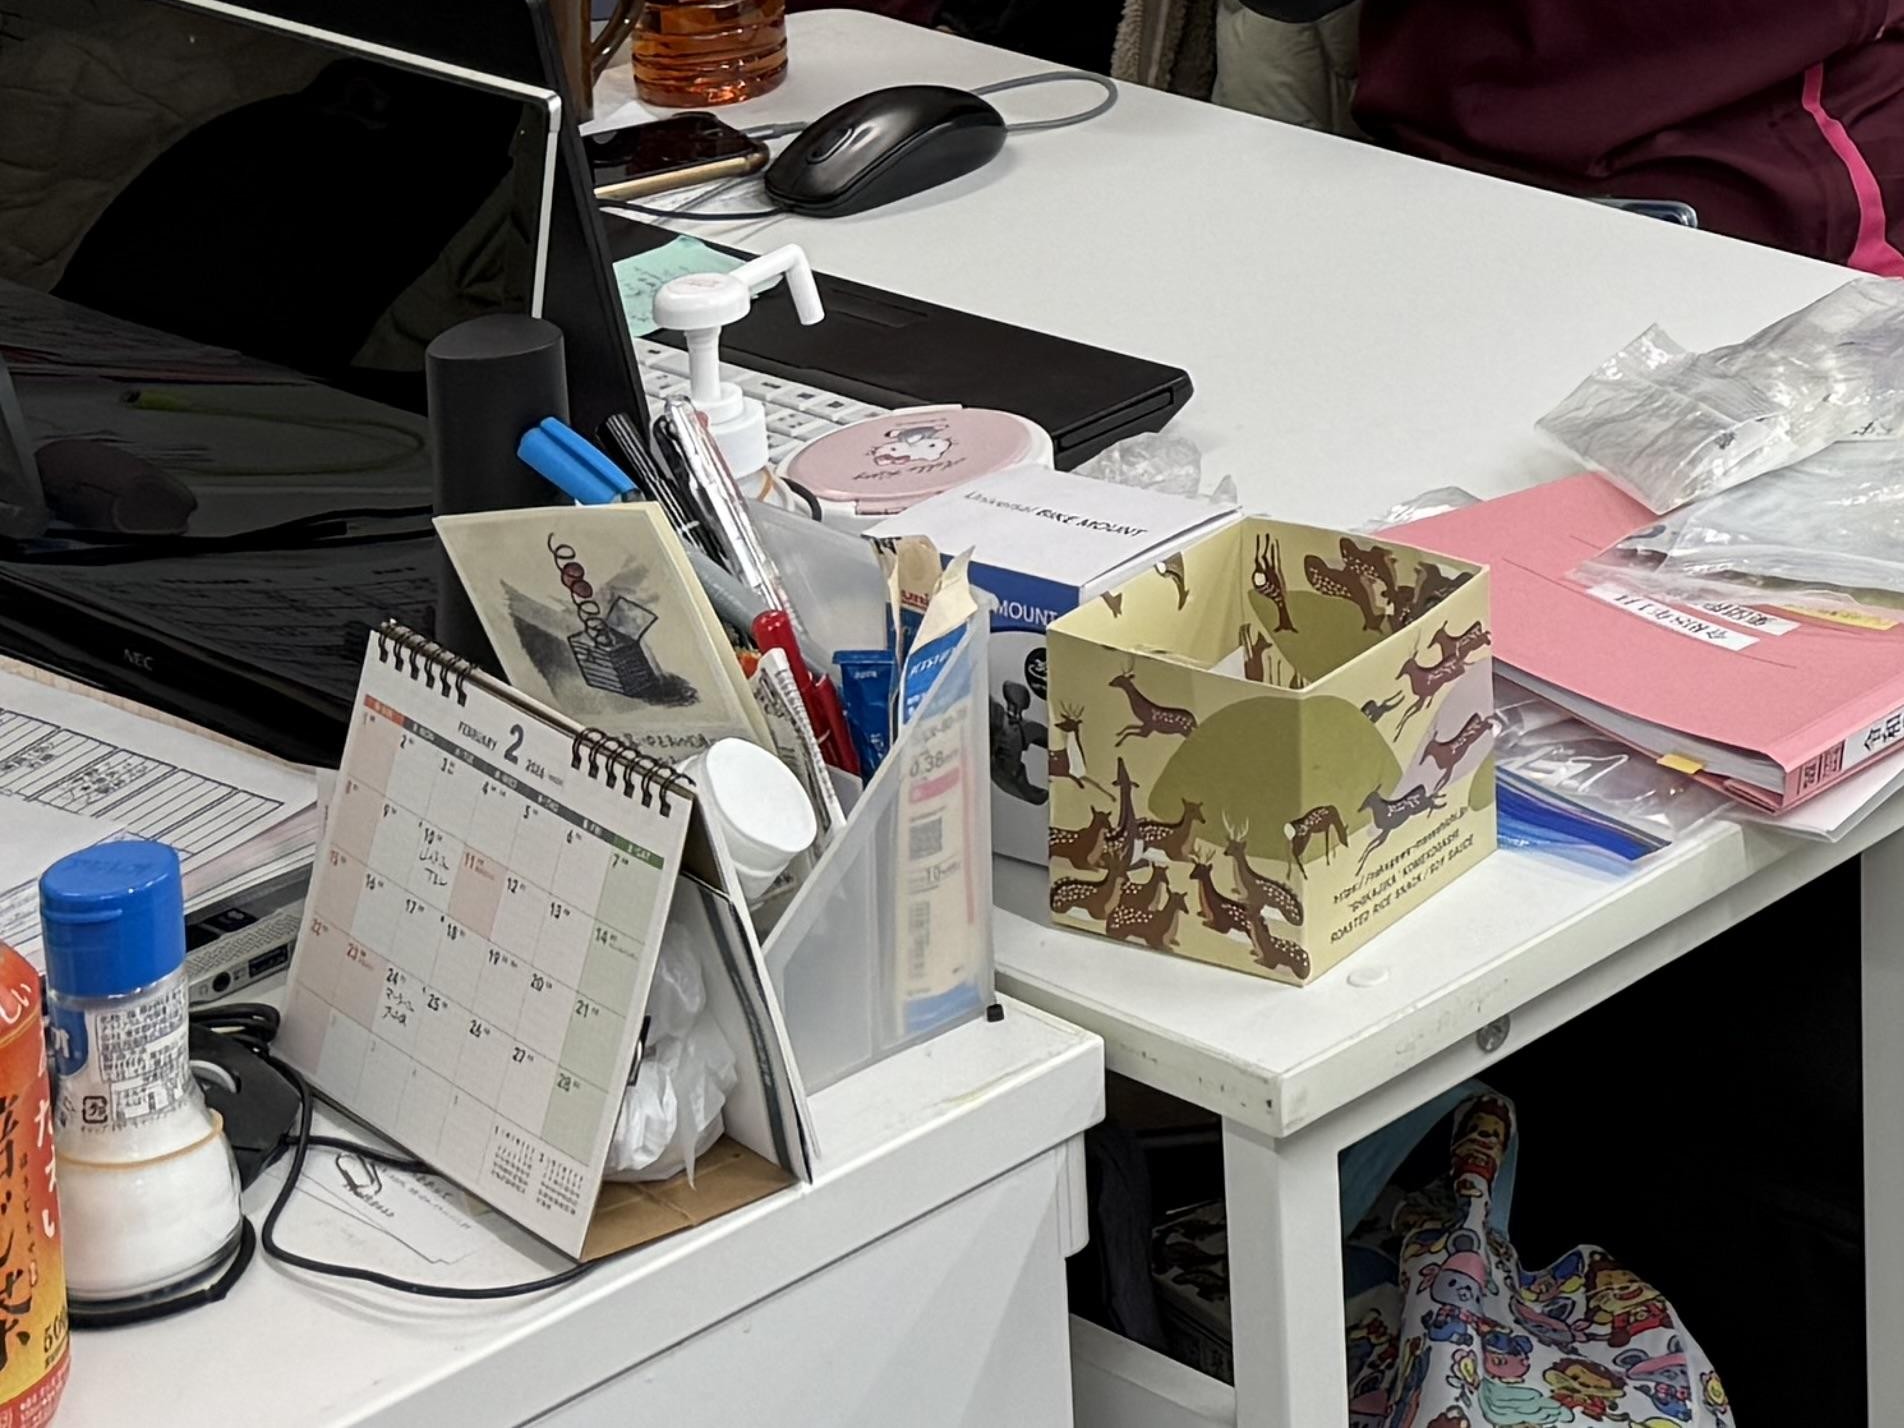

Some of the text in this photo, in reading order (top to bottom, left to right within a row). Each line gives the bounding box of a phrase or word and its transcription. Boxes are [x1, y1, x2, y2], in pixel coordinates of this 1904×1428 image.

[1076, 517, 1149, 537] MOUNT
[504, 723, 524, 765] 2
[464, 852, 478, 870] 11
[506, 876, 520, 894] 12
[550, 902, 563, 919] 13
[595, 927, 609, 945] 14
[1331, 910, 1371, 944] ROASTED
[530, 973, 544, 992] 20
[576, 999, 591, 1019] 21
[386, 967, 400, 986] 24
[427, 993, 440, 1013] 25
[469, 1019, 483, 1038] 26
[512, 1046, 526, 1064] 27
[557, 1072, 572, 1092] 28
